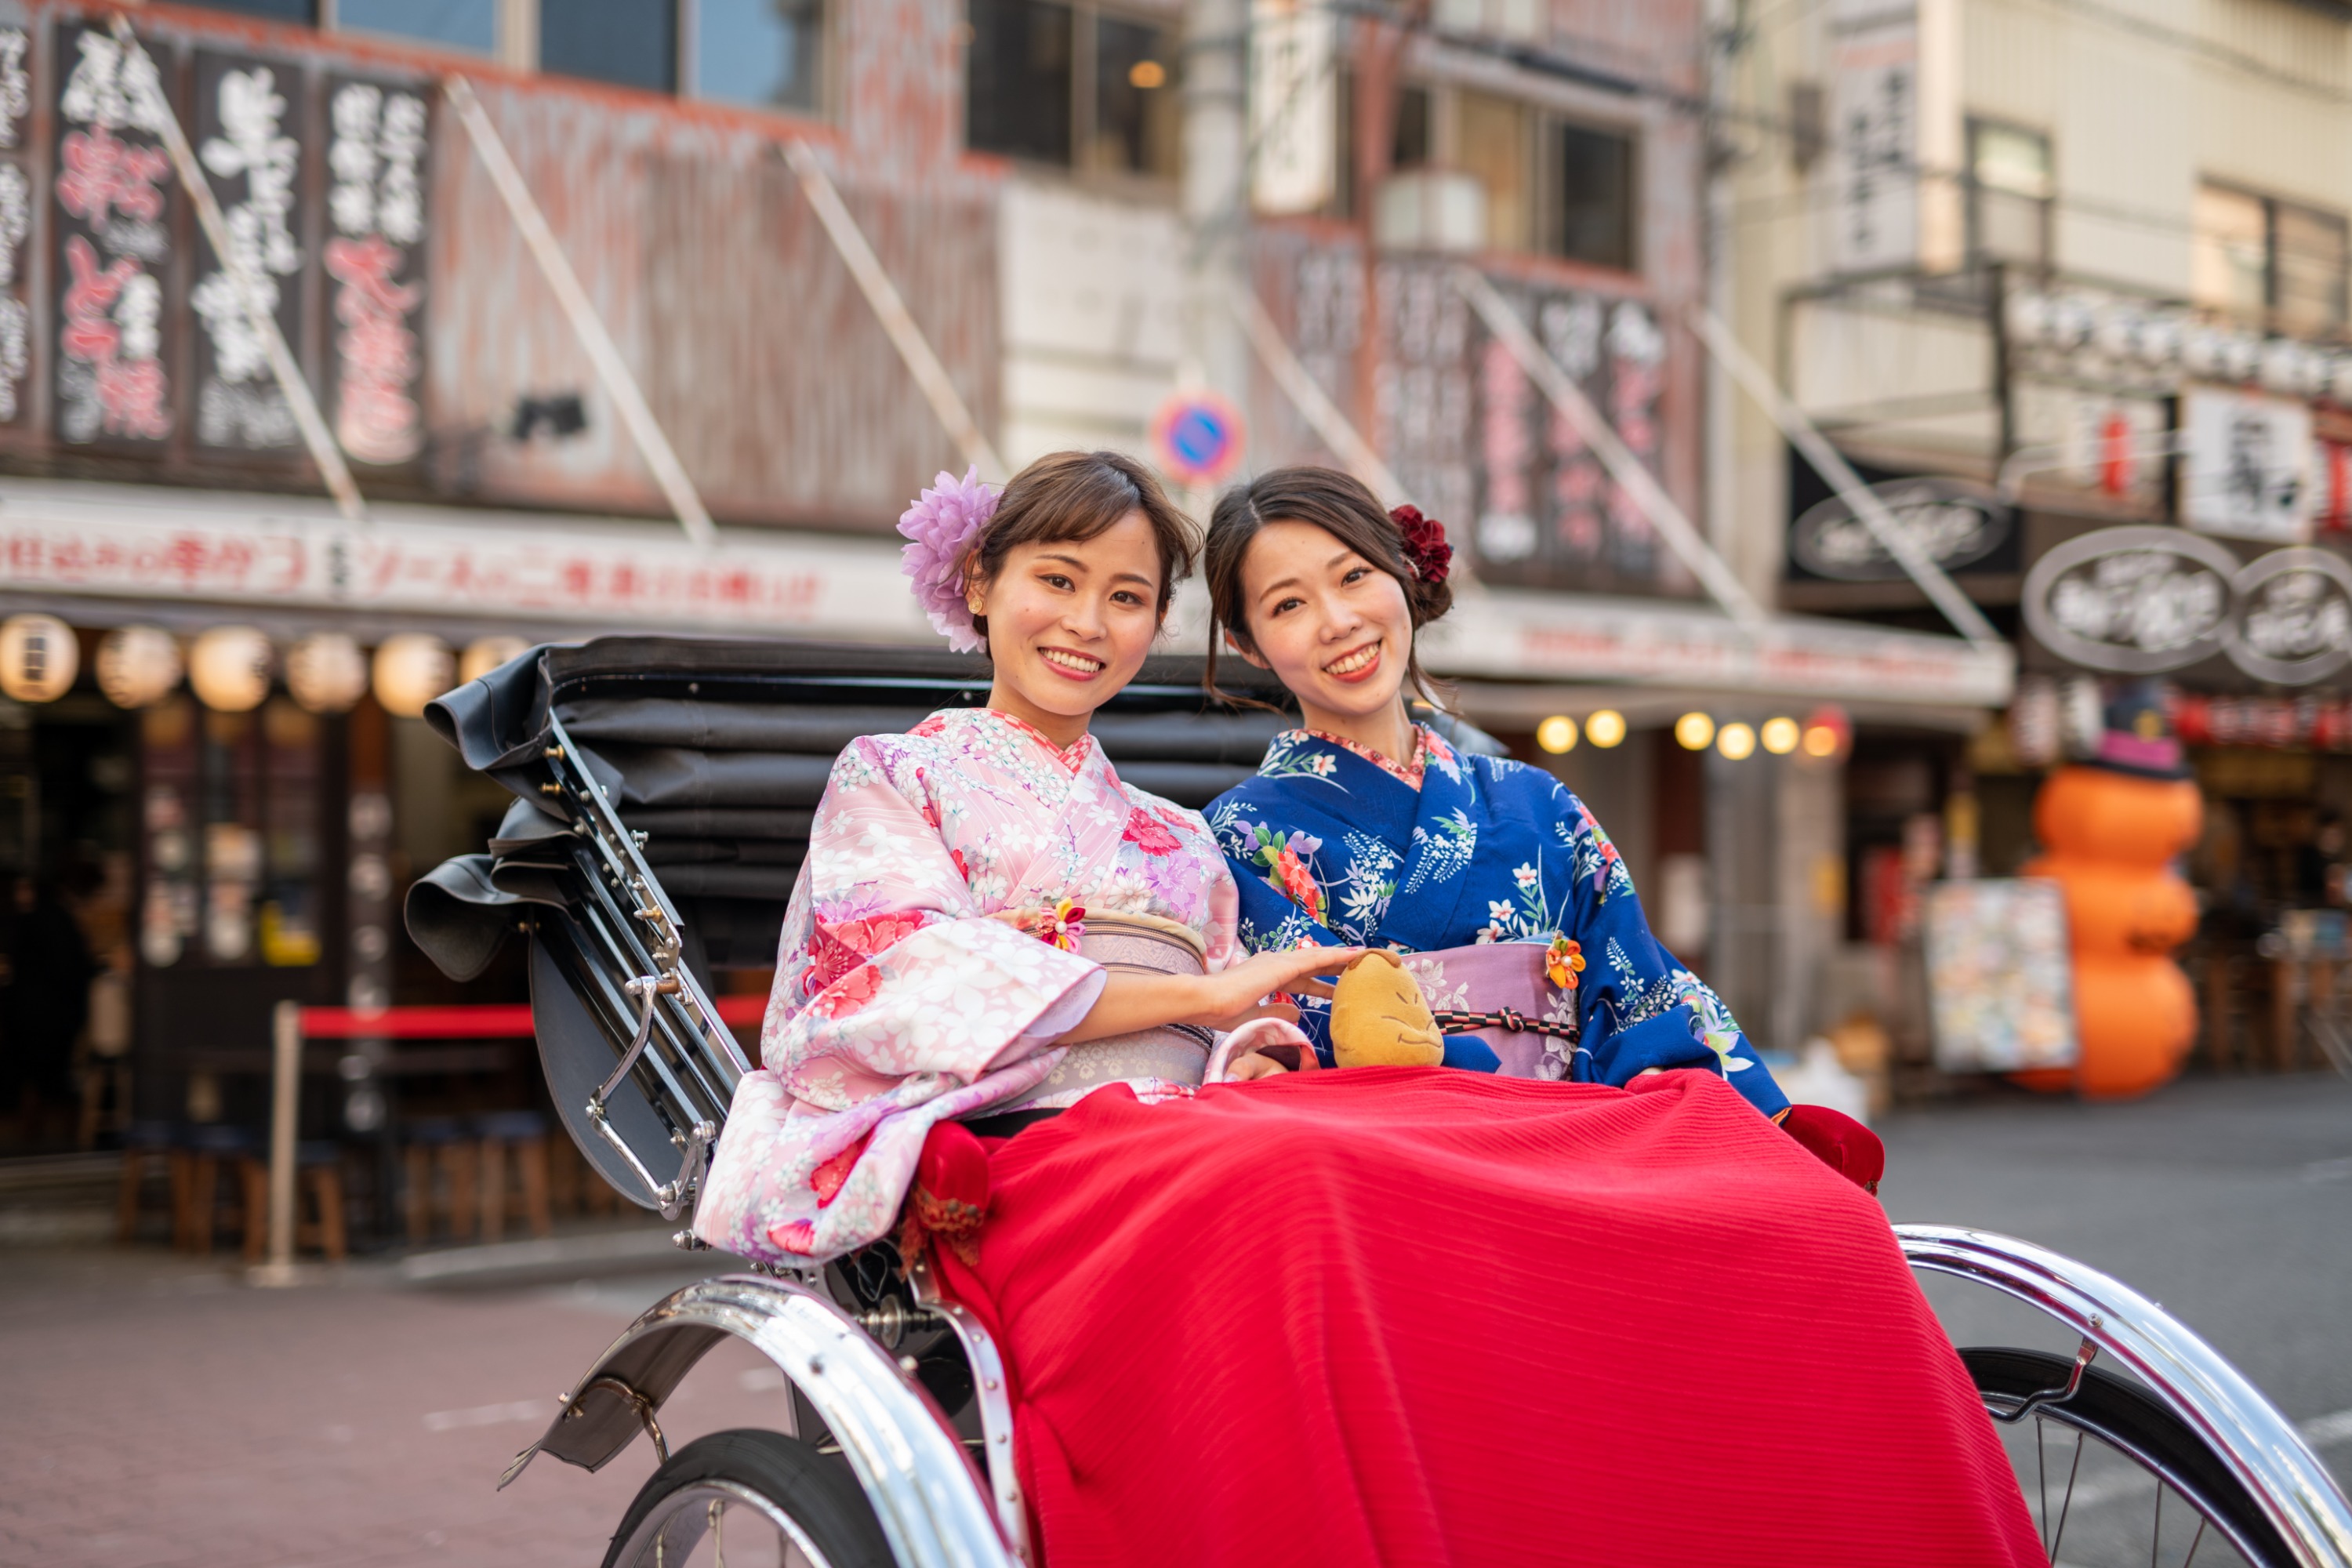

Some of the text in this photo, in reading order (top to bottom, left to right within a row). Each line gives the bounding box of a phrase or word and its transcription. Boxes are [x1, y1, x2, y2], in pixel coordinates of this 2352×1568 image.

[0, 527, 306, 593] 仕込みの串かつ
